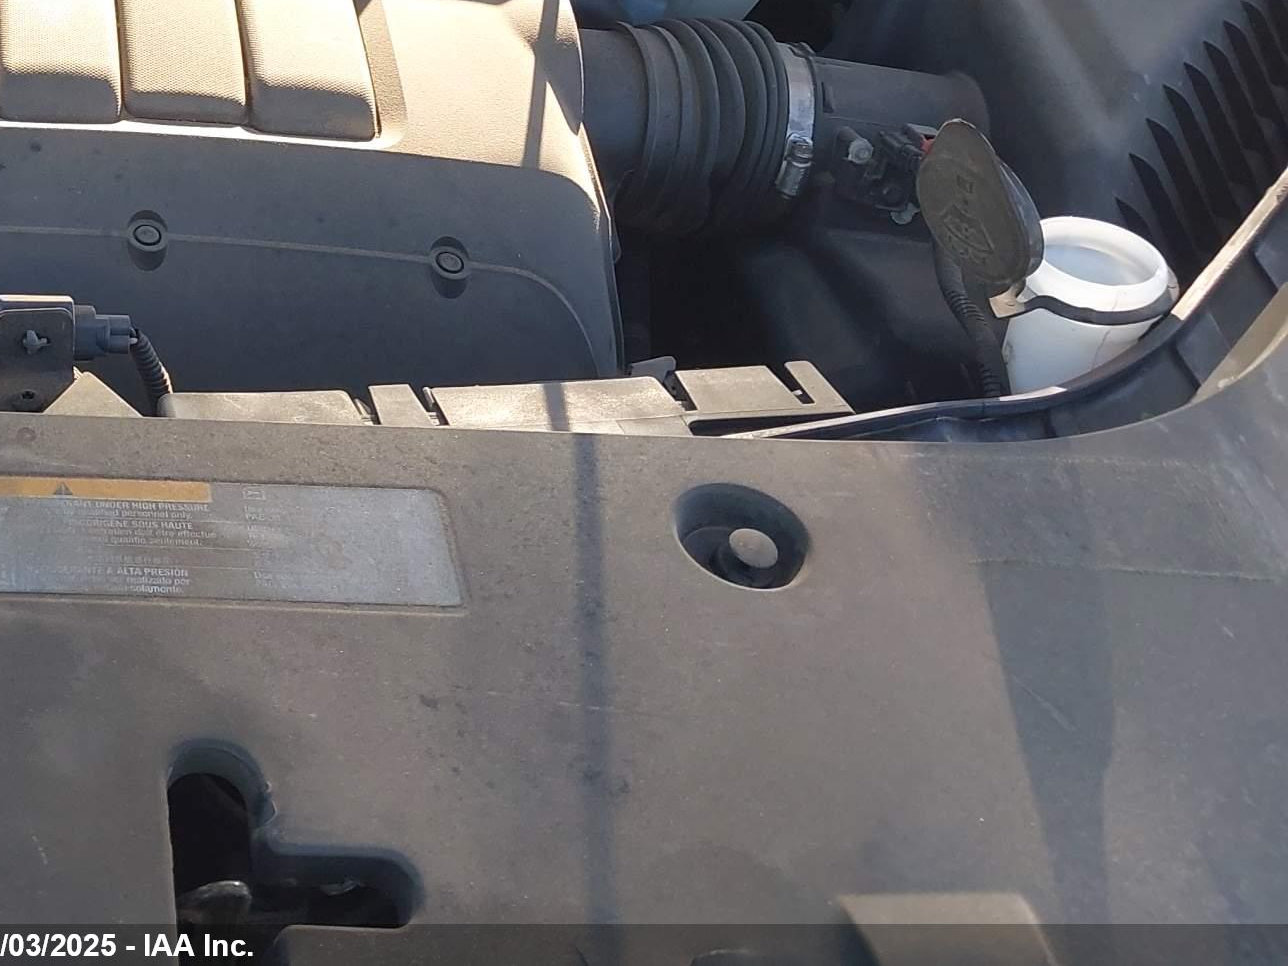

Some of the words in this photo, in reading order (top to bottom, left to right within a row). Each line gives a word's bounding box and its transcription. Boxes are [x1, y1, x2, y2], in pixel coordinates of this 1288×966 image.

[131, 501, 156, 511] HIGH
[158, 503, 210, 512] PRESSURE
[122, 509, 168, 519] personnel
[131, 520, 158, 529] SOUS
[160, 521, 193, 530] HAUTE
[116, 566, 142, 576] ALTA
[174, 577, 191, 587] por
